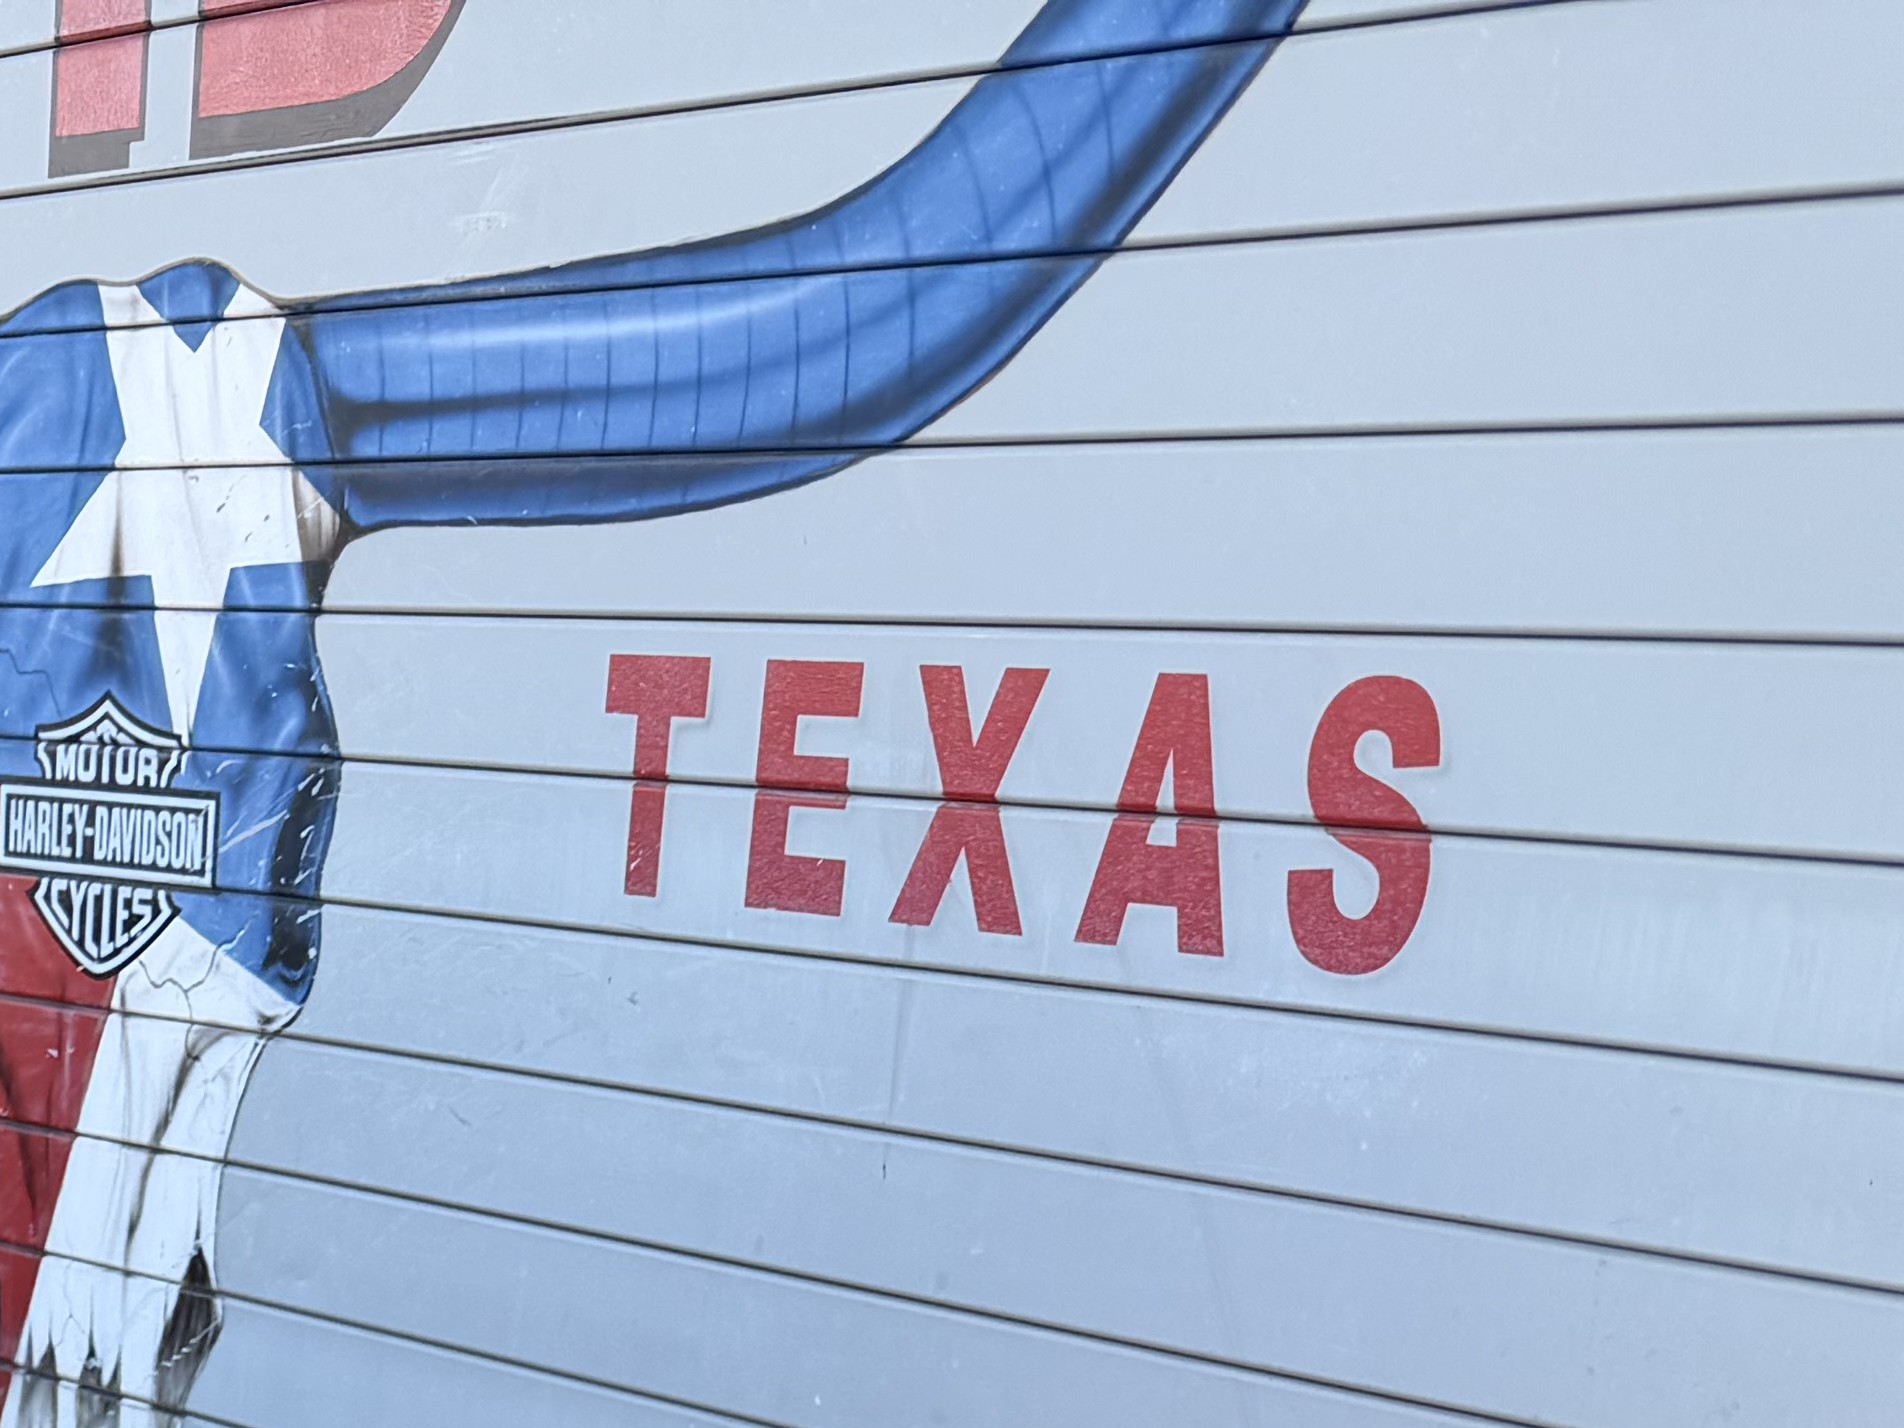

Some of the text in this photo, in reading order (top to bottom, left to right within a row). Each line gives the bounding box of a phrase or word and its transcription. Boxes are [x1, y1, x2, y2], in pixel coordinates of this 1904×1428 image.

[55, 744, 159, 788] MOTOR
[8, 798, 205, 871] HARLEY-DAVIDSON
[605, 653, 1441, 975] TEXAS
[51, 877, 153, 959] CYCLES
